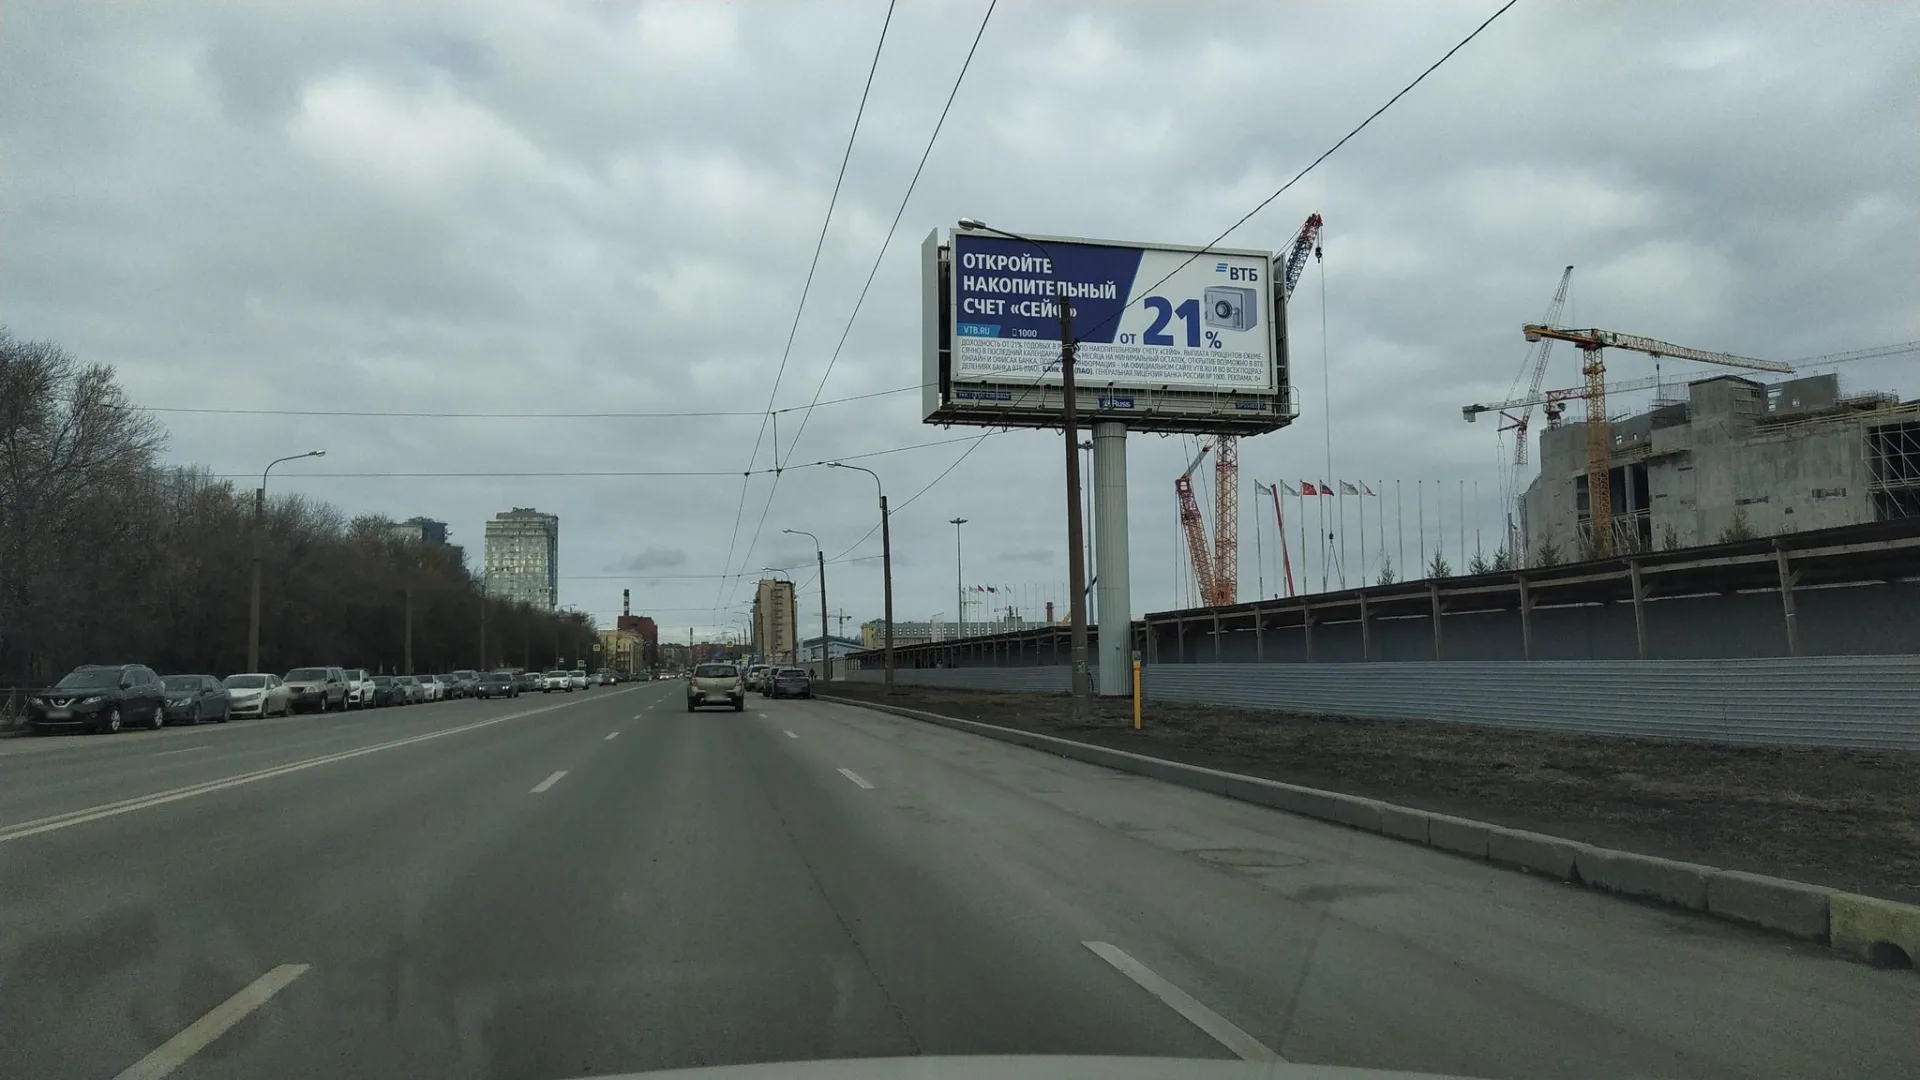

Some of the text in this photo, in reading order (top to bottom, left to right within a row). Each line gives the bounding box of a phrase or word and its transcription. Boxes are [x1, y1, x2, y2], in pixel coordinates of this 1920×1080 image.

[963, 253, 1052, 273] ОТКРОЙТЕ
[1230, 267, 1258, 281] ВТБ
[963, 275, 1116, 299] НАКОПИТЕЛЬНЫЙ
[963, 298, 1005, 314] СЧЕТ
[964, 326, 990, 335] VTB.RU
[1018, 329, 1037, 337] 1000
[1120, 333, 1137, 344] ОТ
[1113, 400, 1131, 408] Russ
